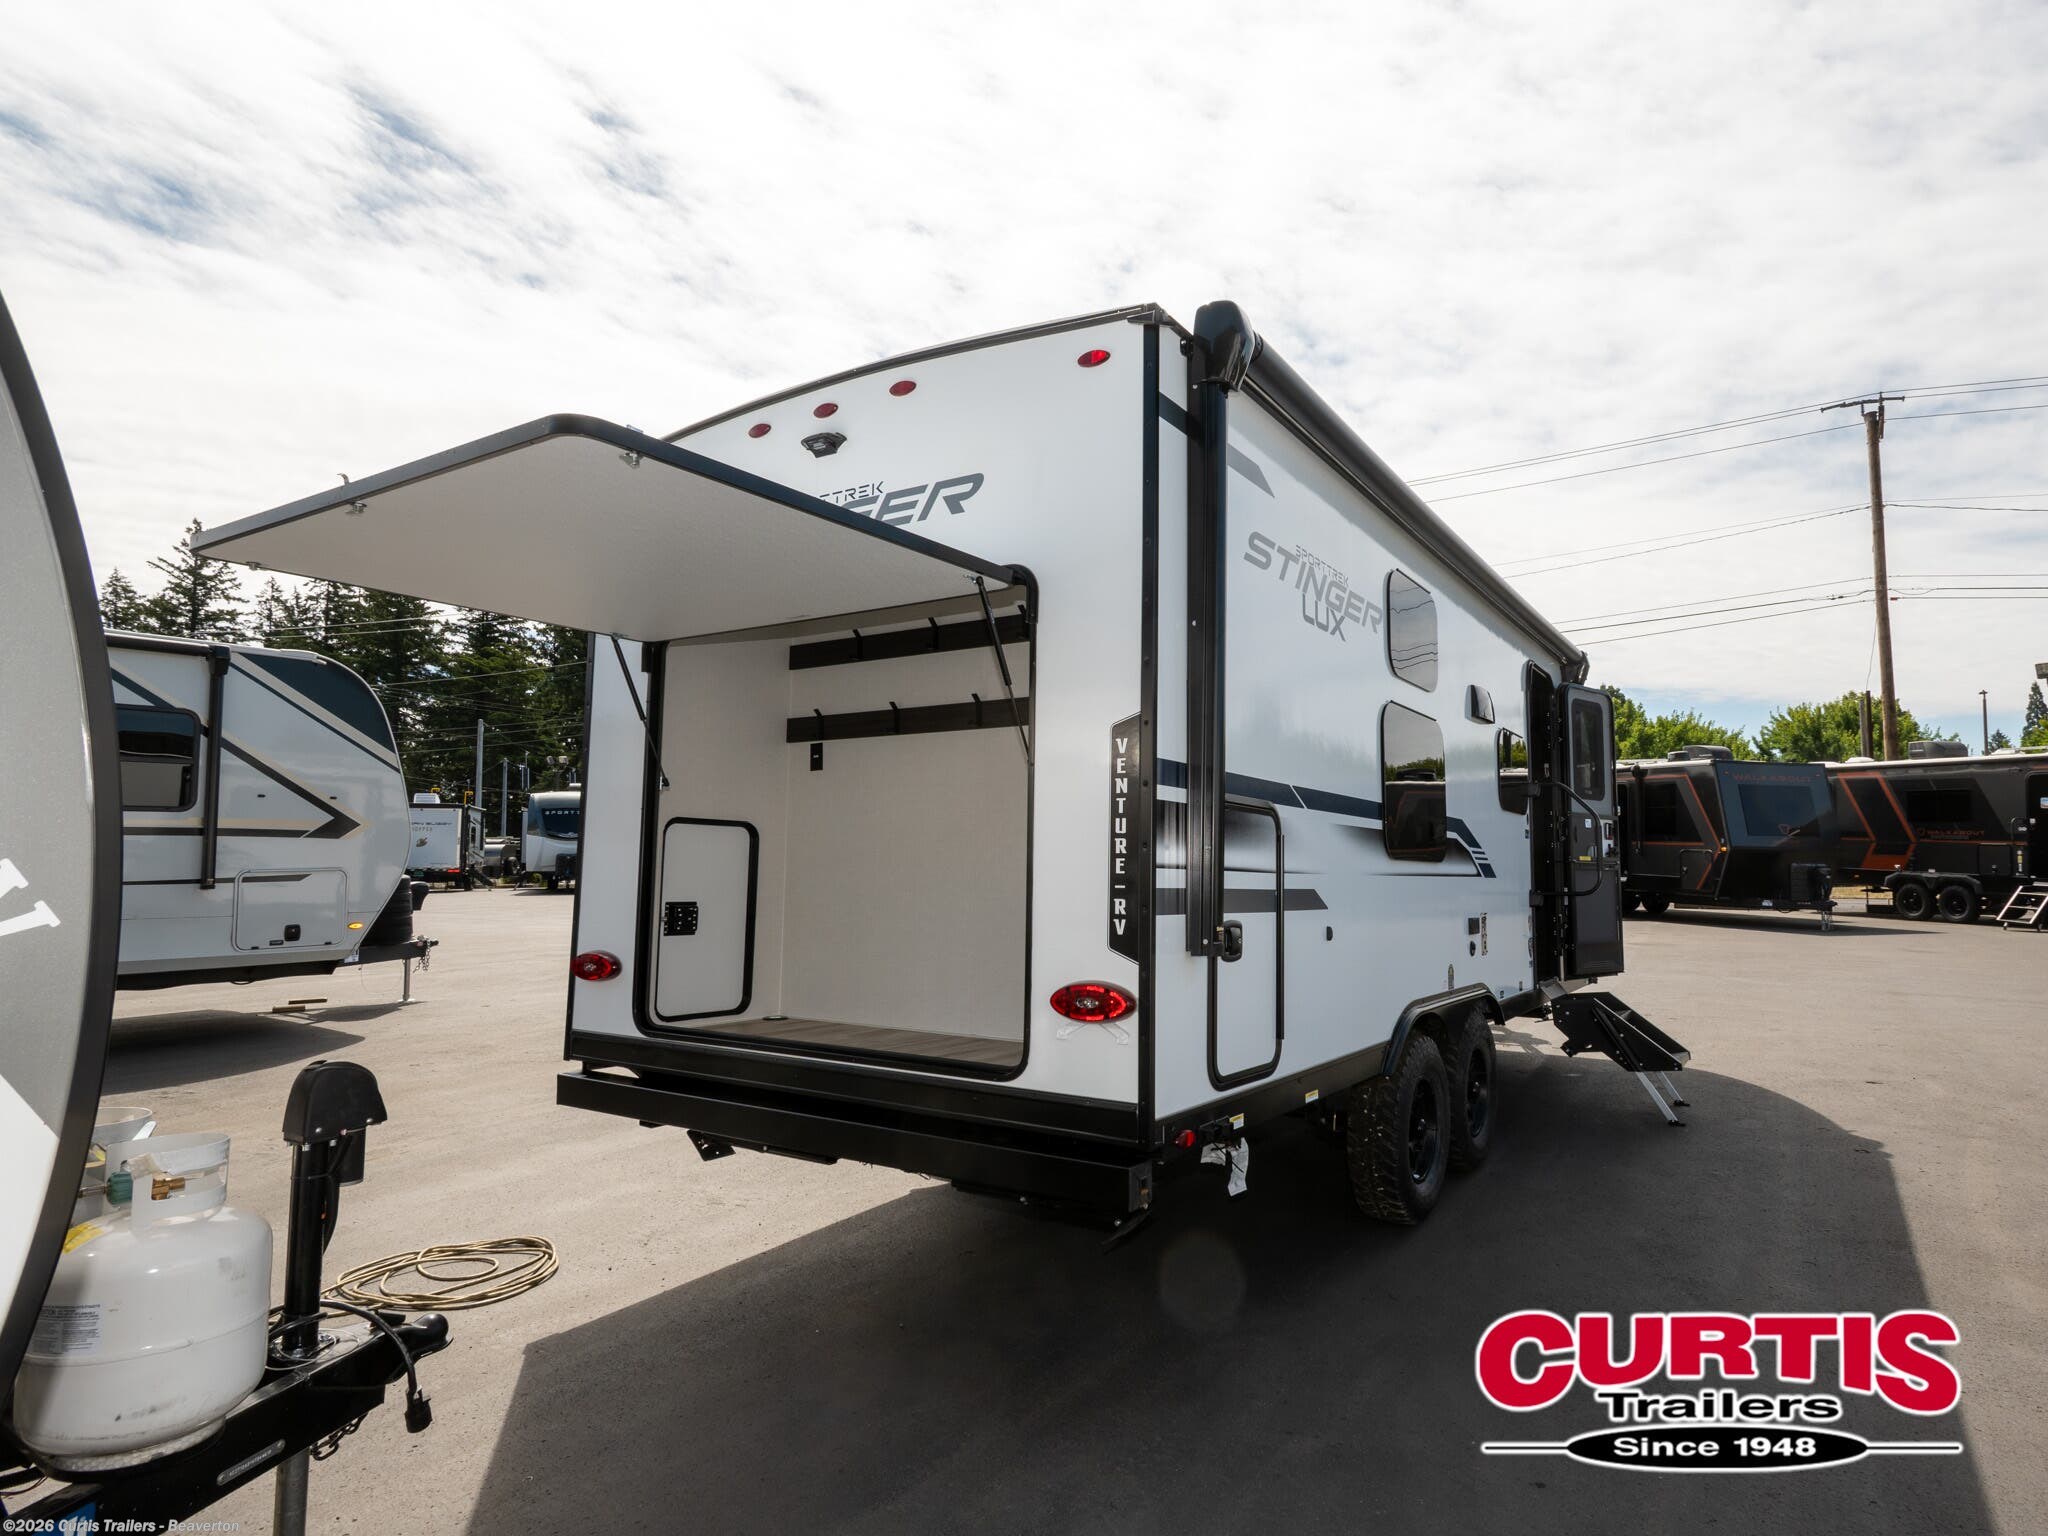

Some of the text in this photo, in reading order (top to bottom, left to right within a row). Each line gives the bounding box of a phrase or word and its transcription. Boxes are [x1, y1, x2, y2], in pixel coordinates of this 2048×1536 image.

[1243, 531, 1383, 634] STINGER
[1295, 544, 1349, 587] SPORTTREK
[1302, 592, 1346, 642] LUX
